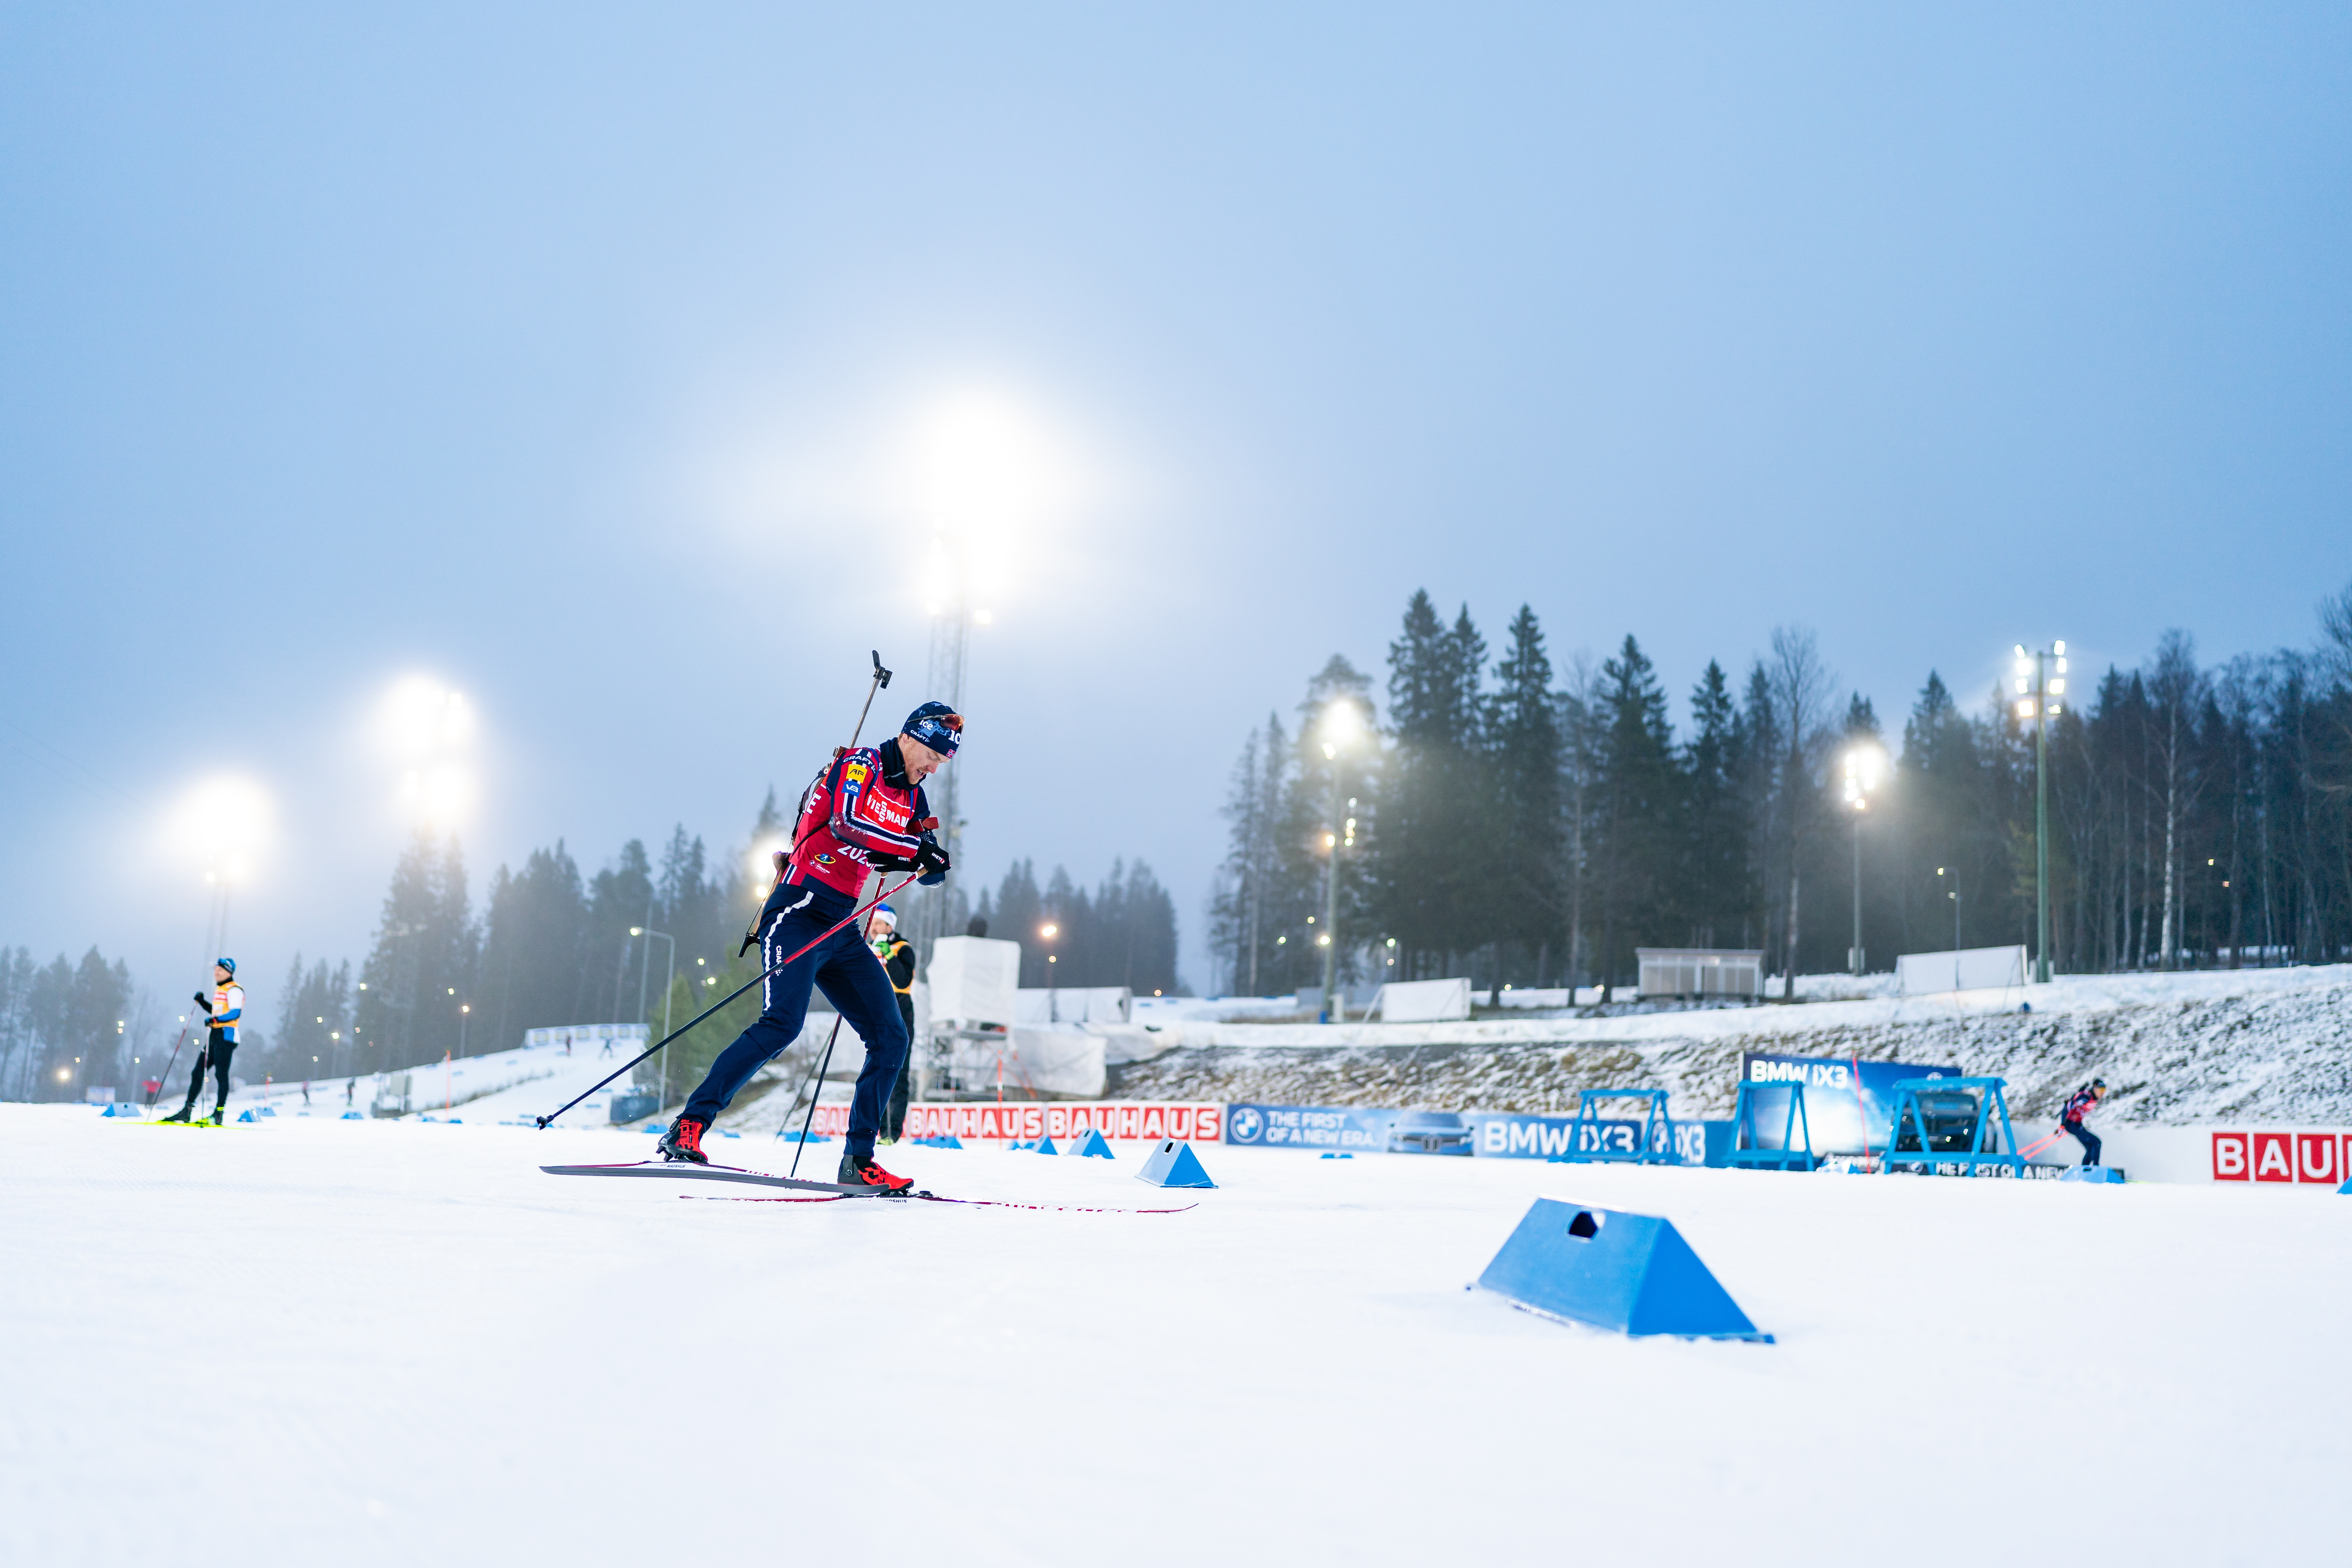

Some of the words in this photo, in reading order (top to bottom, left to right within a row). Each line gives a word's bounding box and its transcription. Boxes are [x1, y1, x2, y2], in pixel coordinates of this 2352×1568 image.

[910, 730, 926, 740] CRAFT
[843, 756, 873, 765] CRAFT
[1750, 1060, 1809, 1083] BMW
[1812, 1064, 1848, 1089] iX3
[911, 1110, 1042, 1136] BAUHAUS
[1049, 1109, 1219, 1137] BAUHAUS
[1266, 1111, 1300, 1127] THE
[1302, 1112, 1347, 1129] FIRST
[1265, 1128, 1288, 1143] OF
[1288, 1129, 1303, 1143] A
[1303, 1129, 1339, 1145] NEW
[1484, 1121, 1573, 1156] BMW
[2216, 1138, 2352, 1179] BAU
